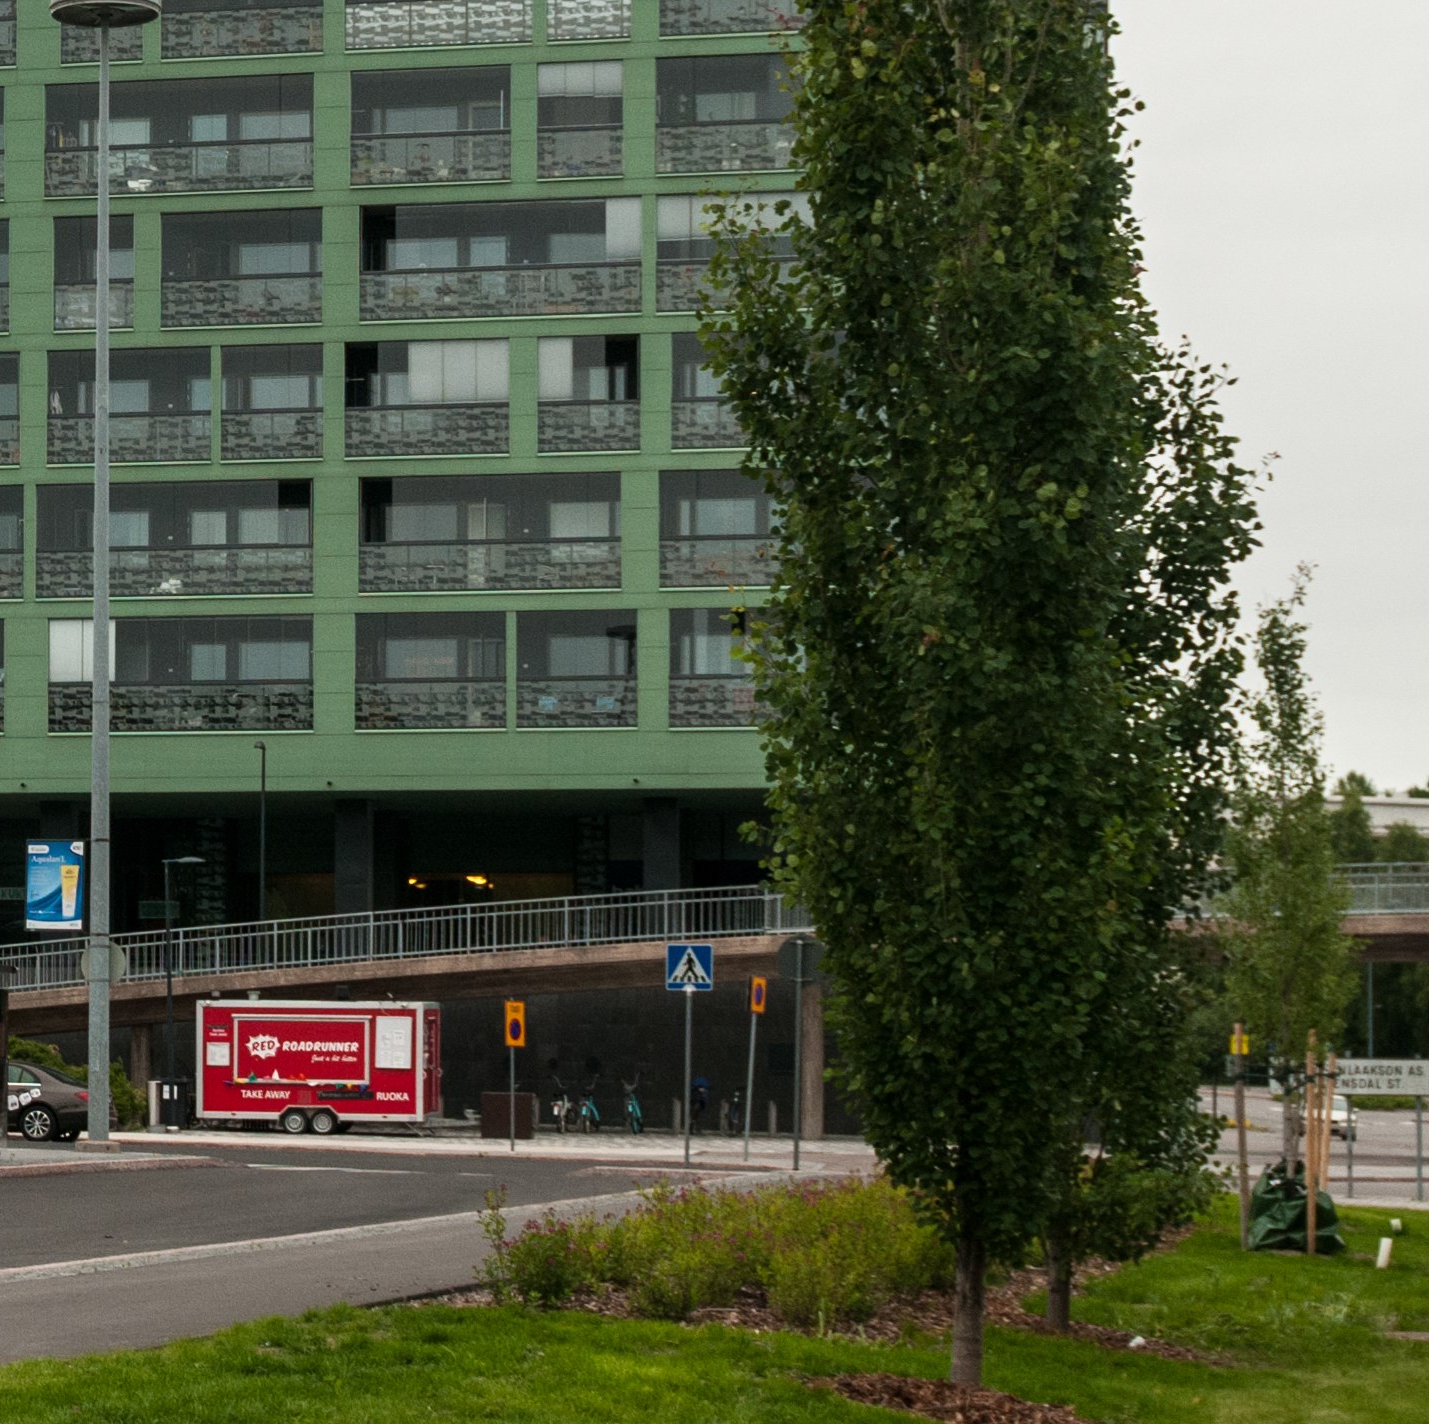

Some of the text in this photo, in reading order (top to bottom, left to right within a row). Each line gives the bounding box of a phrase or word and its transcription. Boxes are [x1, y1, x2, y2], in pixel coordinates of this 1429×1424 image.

[251, 1040, 359, 1053] RED ROADRUNNER
[241, 1089, 291, 1100] TAKE AWAY
[376, 1092, 409, 1102] RUOKA
